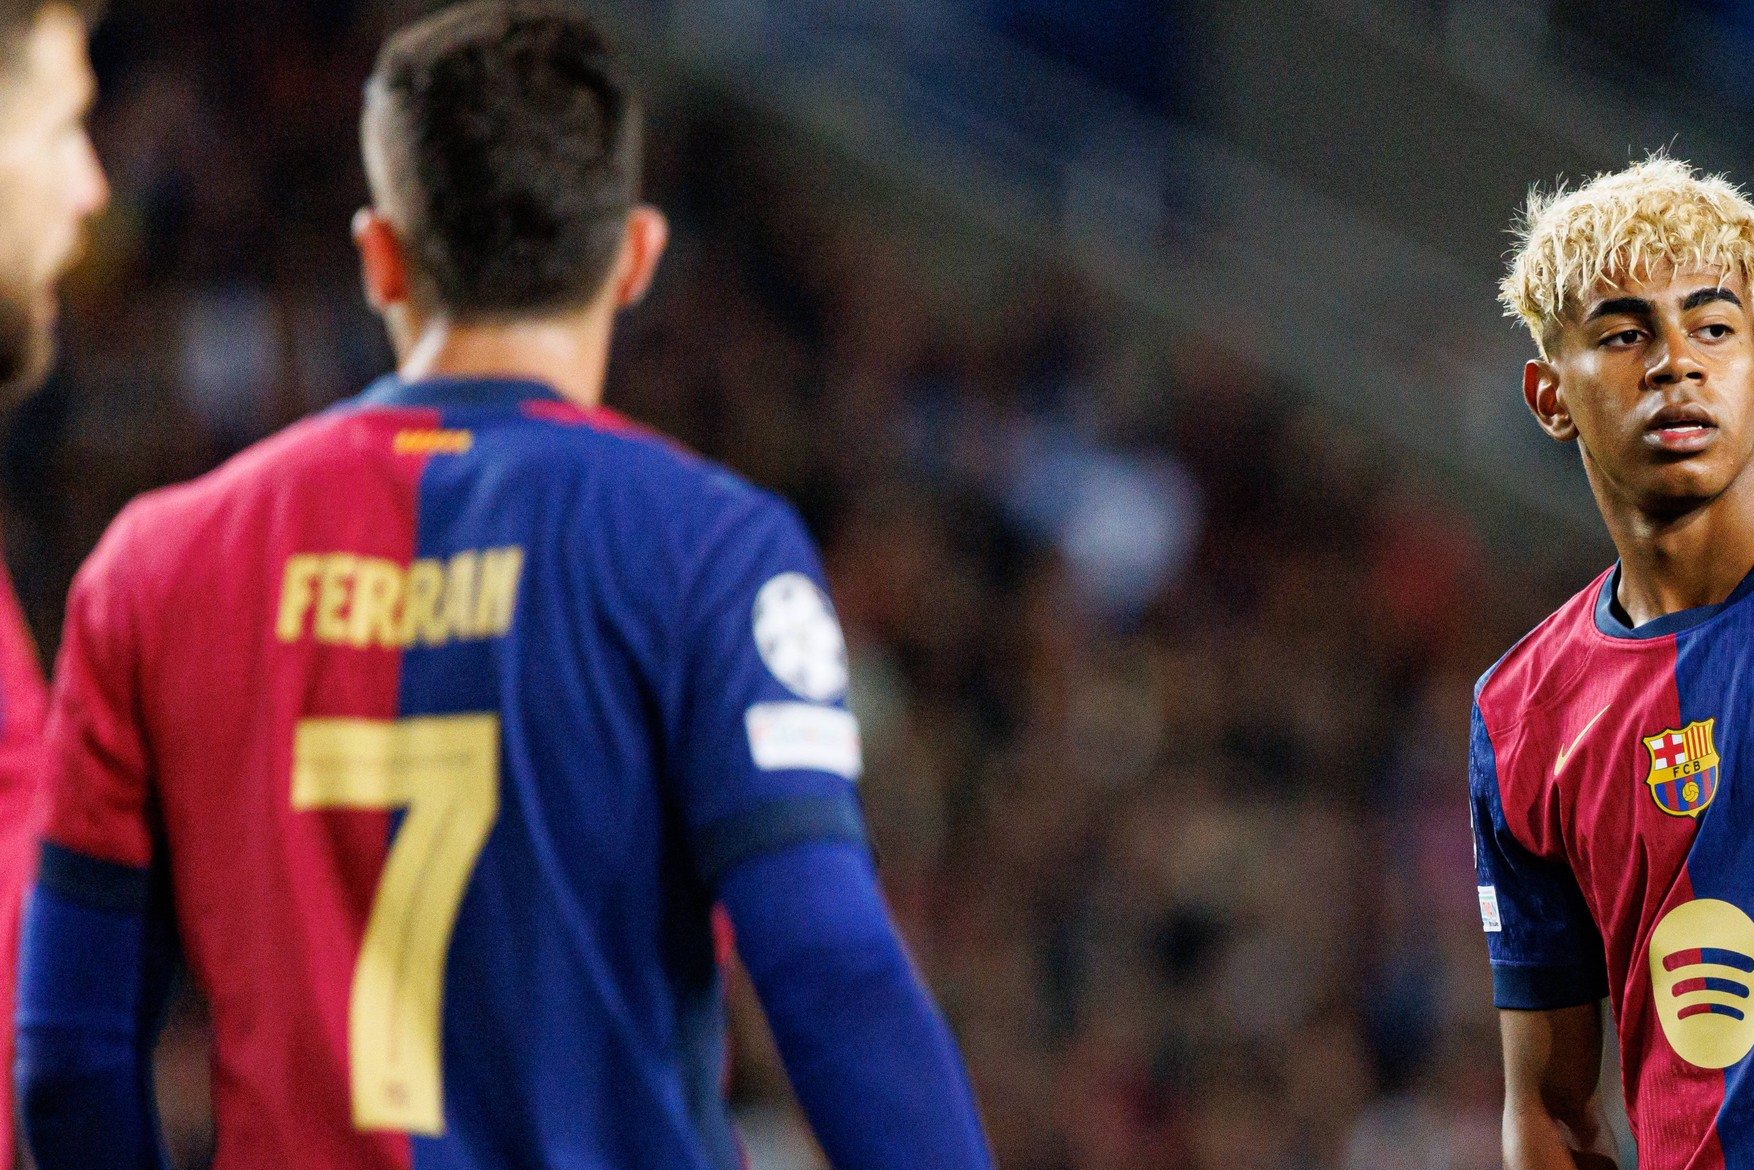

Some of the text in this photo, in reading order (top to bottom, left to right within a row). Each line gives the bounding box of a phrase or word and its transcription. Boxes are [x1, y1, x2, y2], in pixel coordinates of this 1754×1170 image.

[276, 547, 523, 645] FERRAN
[1673, 761, 1701, 778] FCB
[292, 713, 500, 1137] 7
